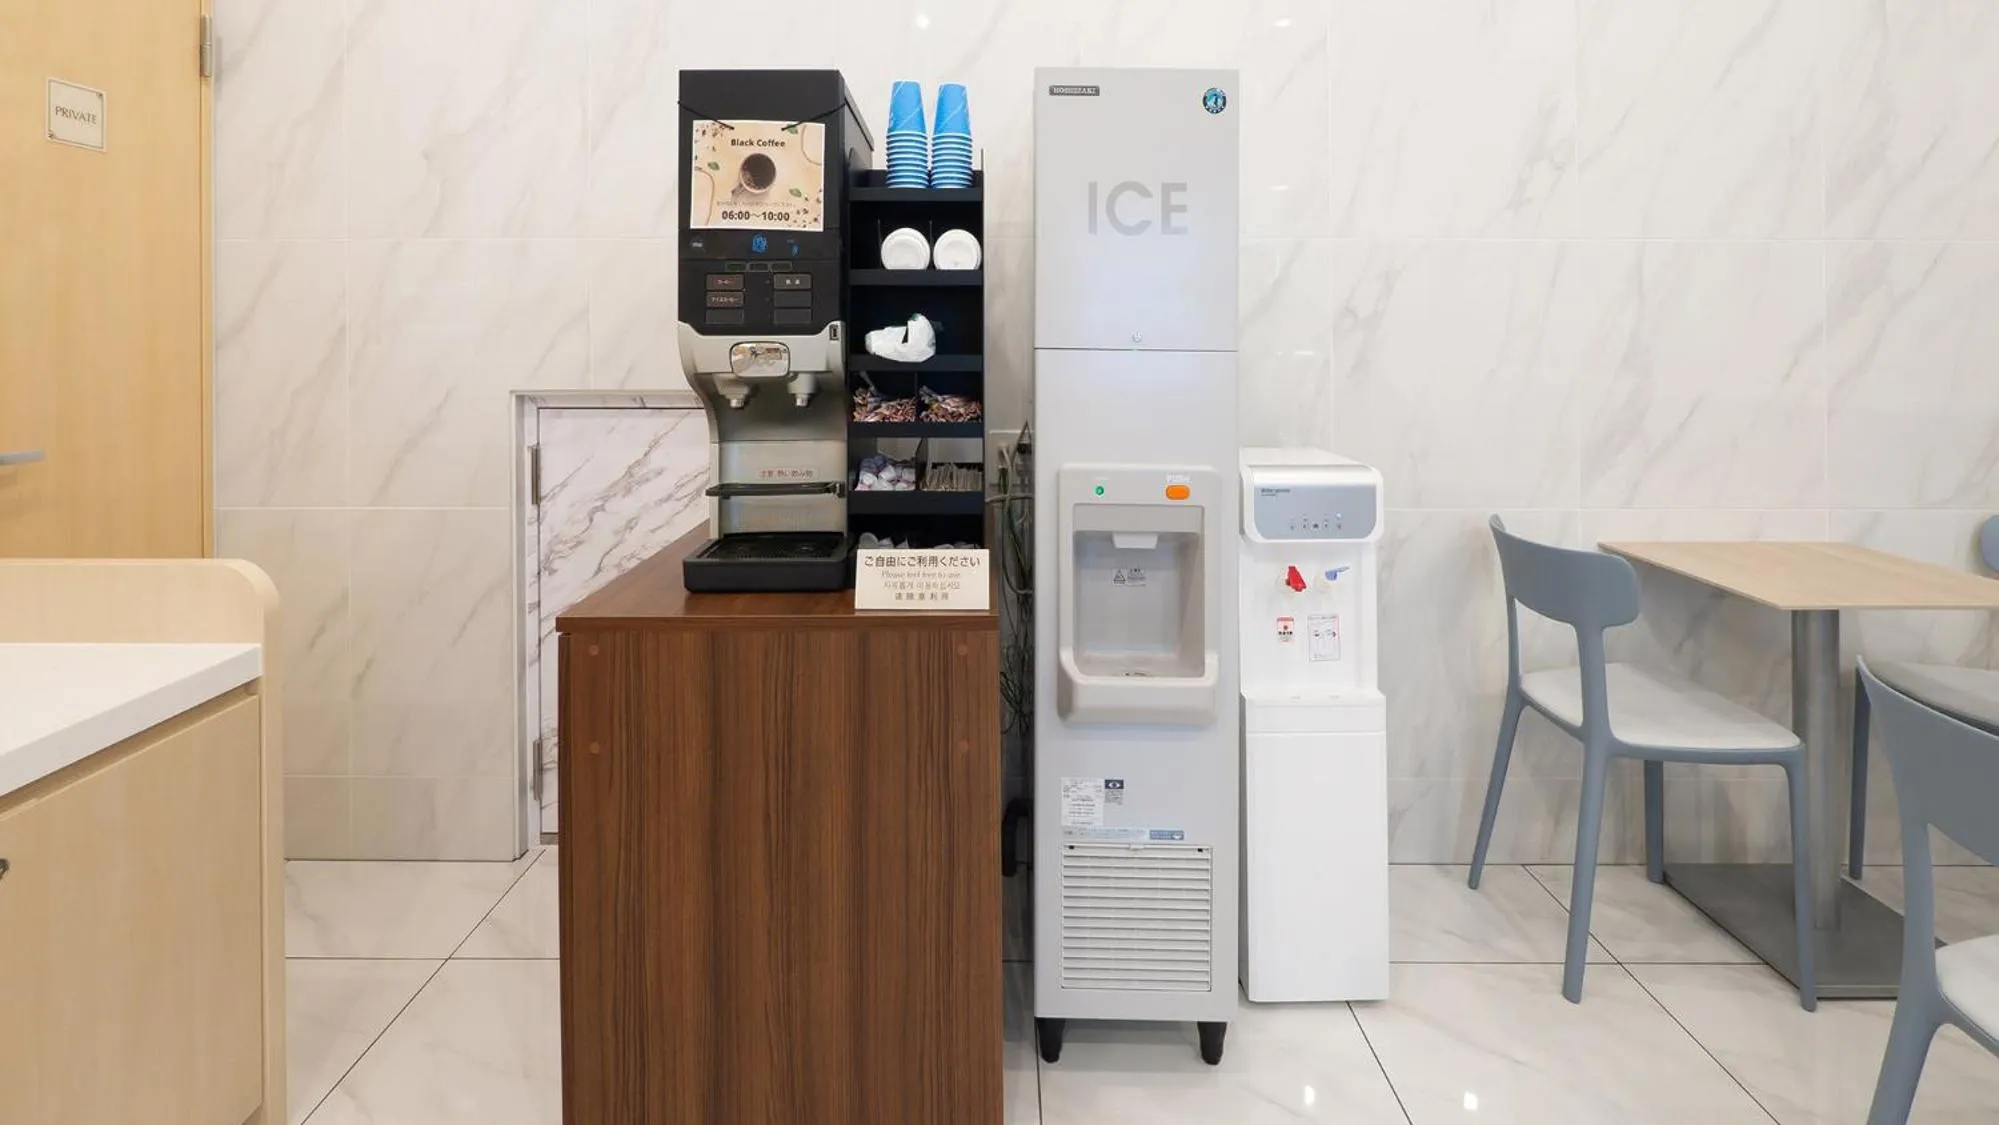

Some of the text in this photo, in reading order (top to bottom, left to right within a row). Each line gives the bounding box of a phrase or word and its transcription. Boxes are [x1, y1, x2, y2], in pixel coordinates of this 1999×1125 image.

[55, 105, 97, 125] PRIVATE
[730, 138, 786, 148] Black Coffee
[1088, 180, 1188, 237] ICE
[864, 555, 981, 568] ご自由にご利用ください
